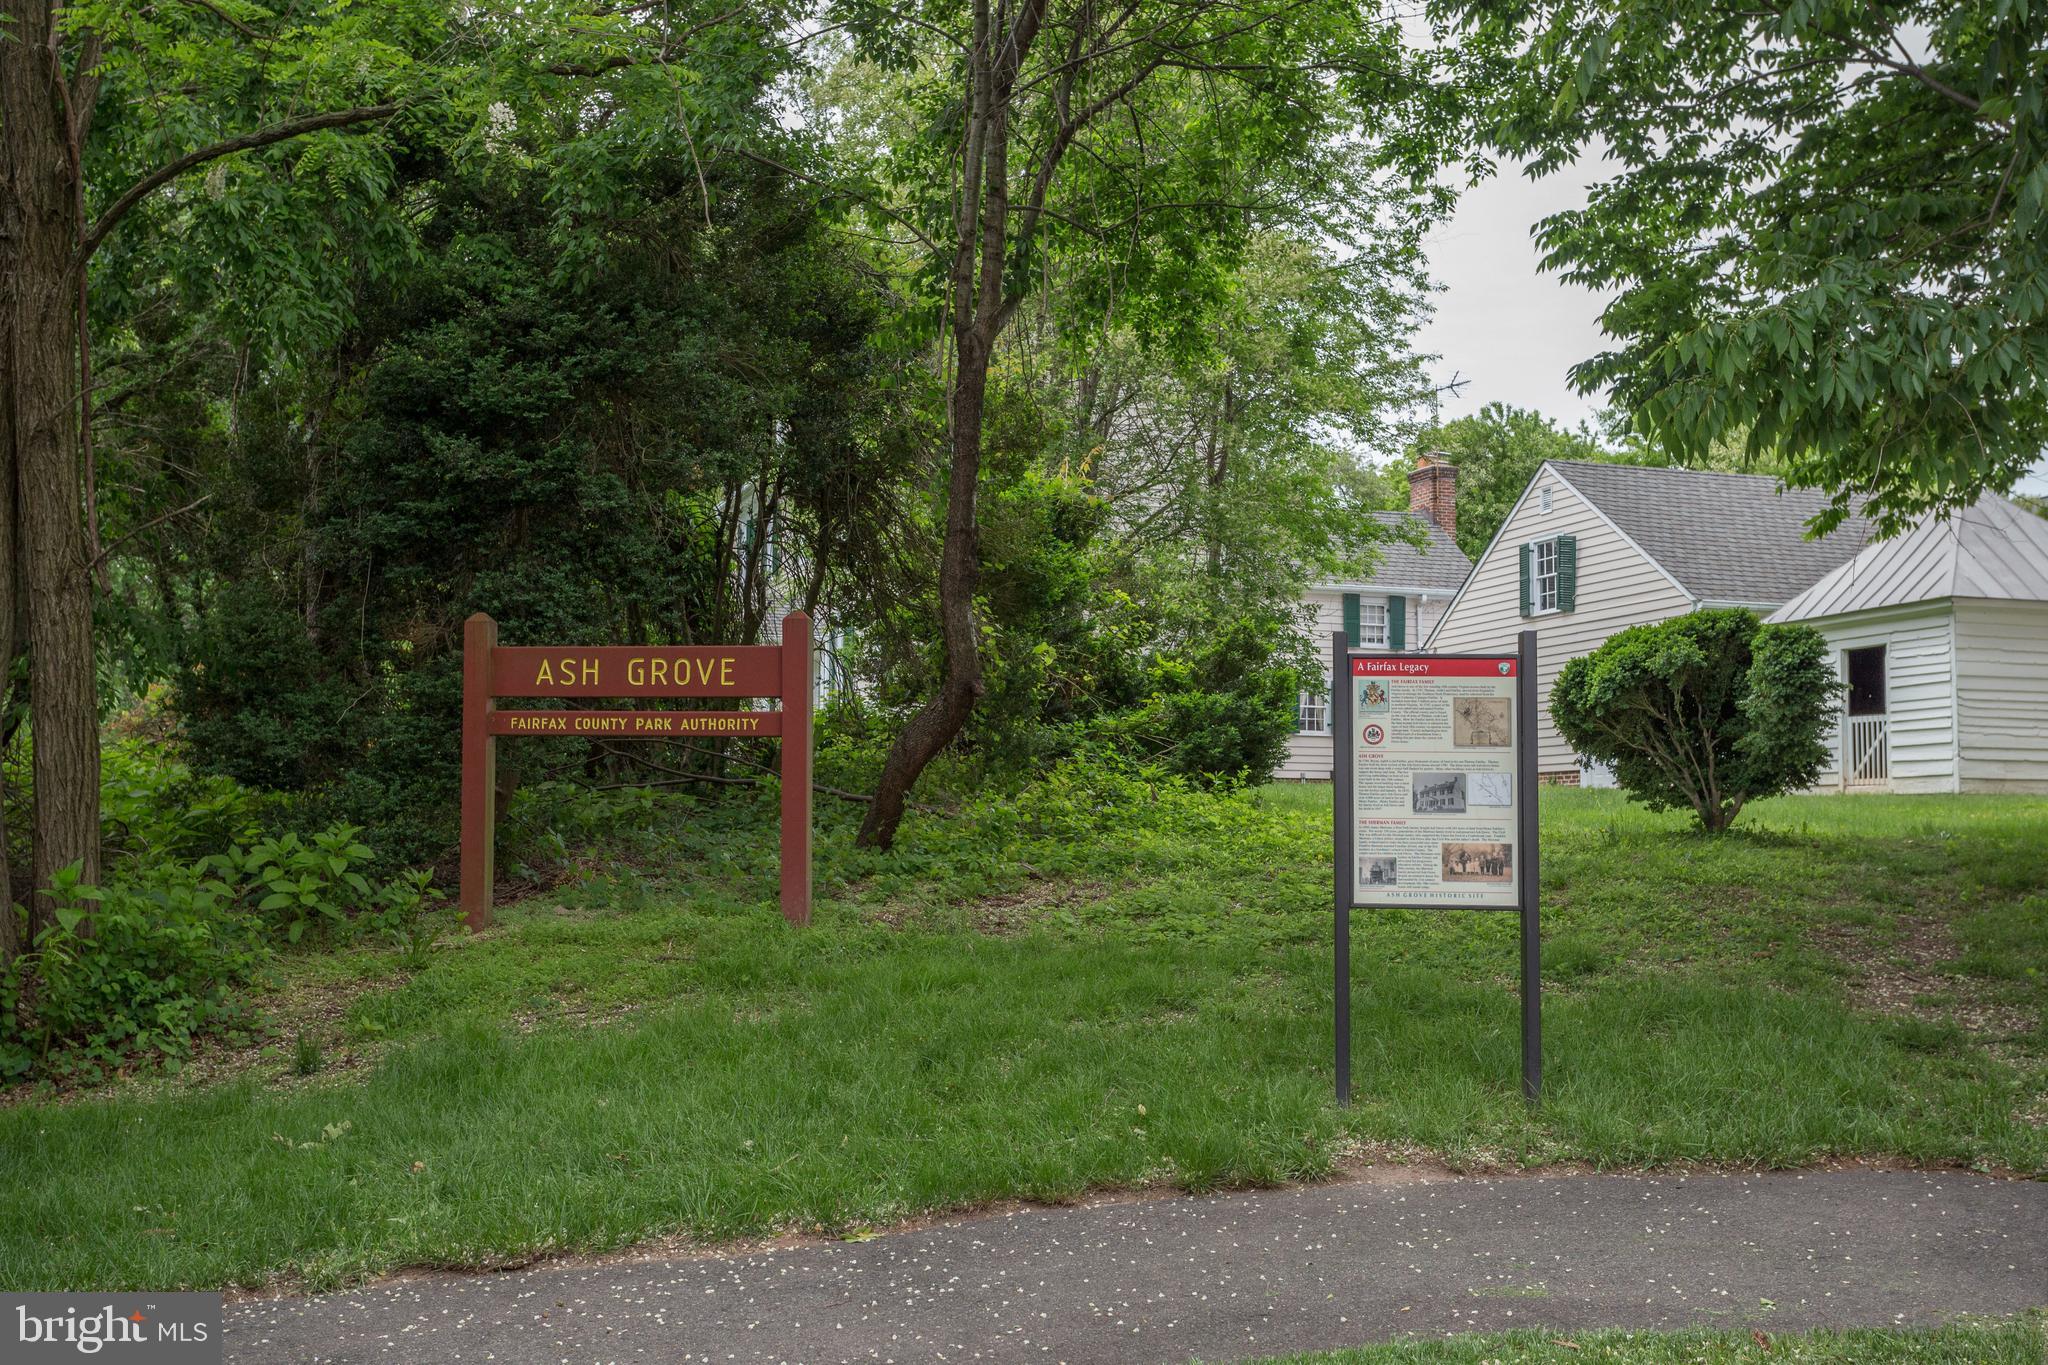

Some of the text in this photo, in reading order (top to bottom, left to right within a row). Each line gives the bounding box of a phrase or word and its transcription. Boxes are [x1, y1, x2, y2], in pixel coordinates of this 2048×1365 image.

[535, 658, 736, 686] ASH GROVE
[1357, 662, 1429, 674] A Fairfax Legacy
[510, 717, 759, 731] FAIRFAX COUNTY PARK AUTHORITY
